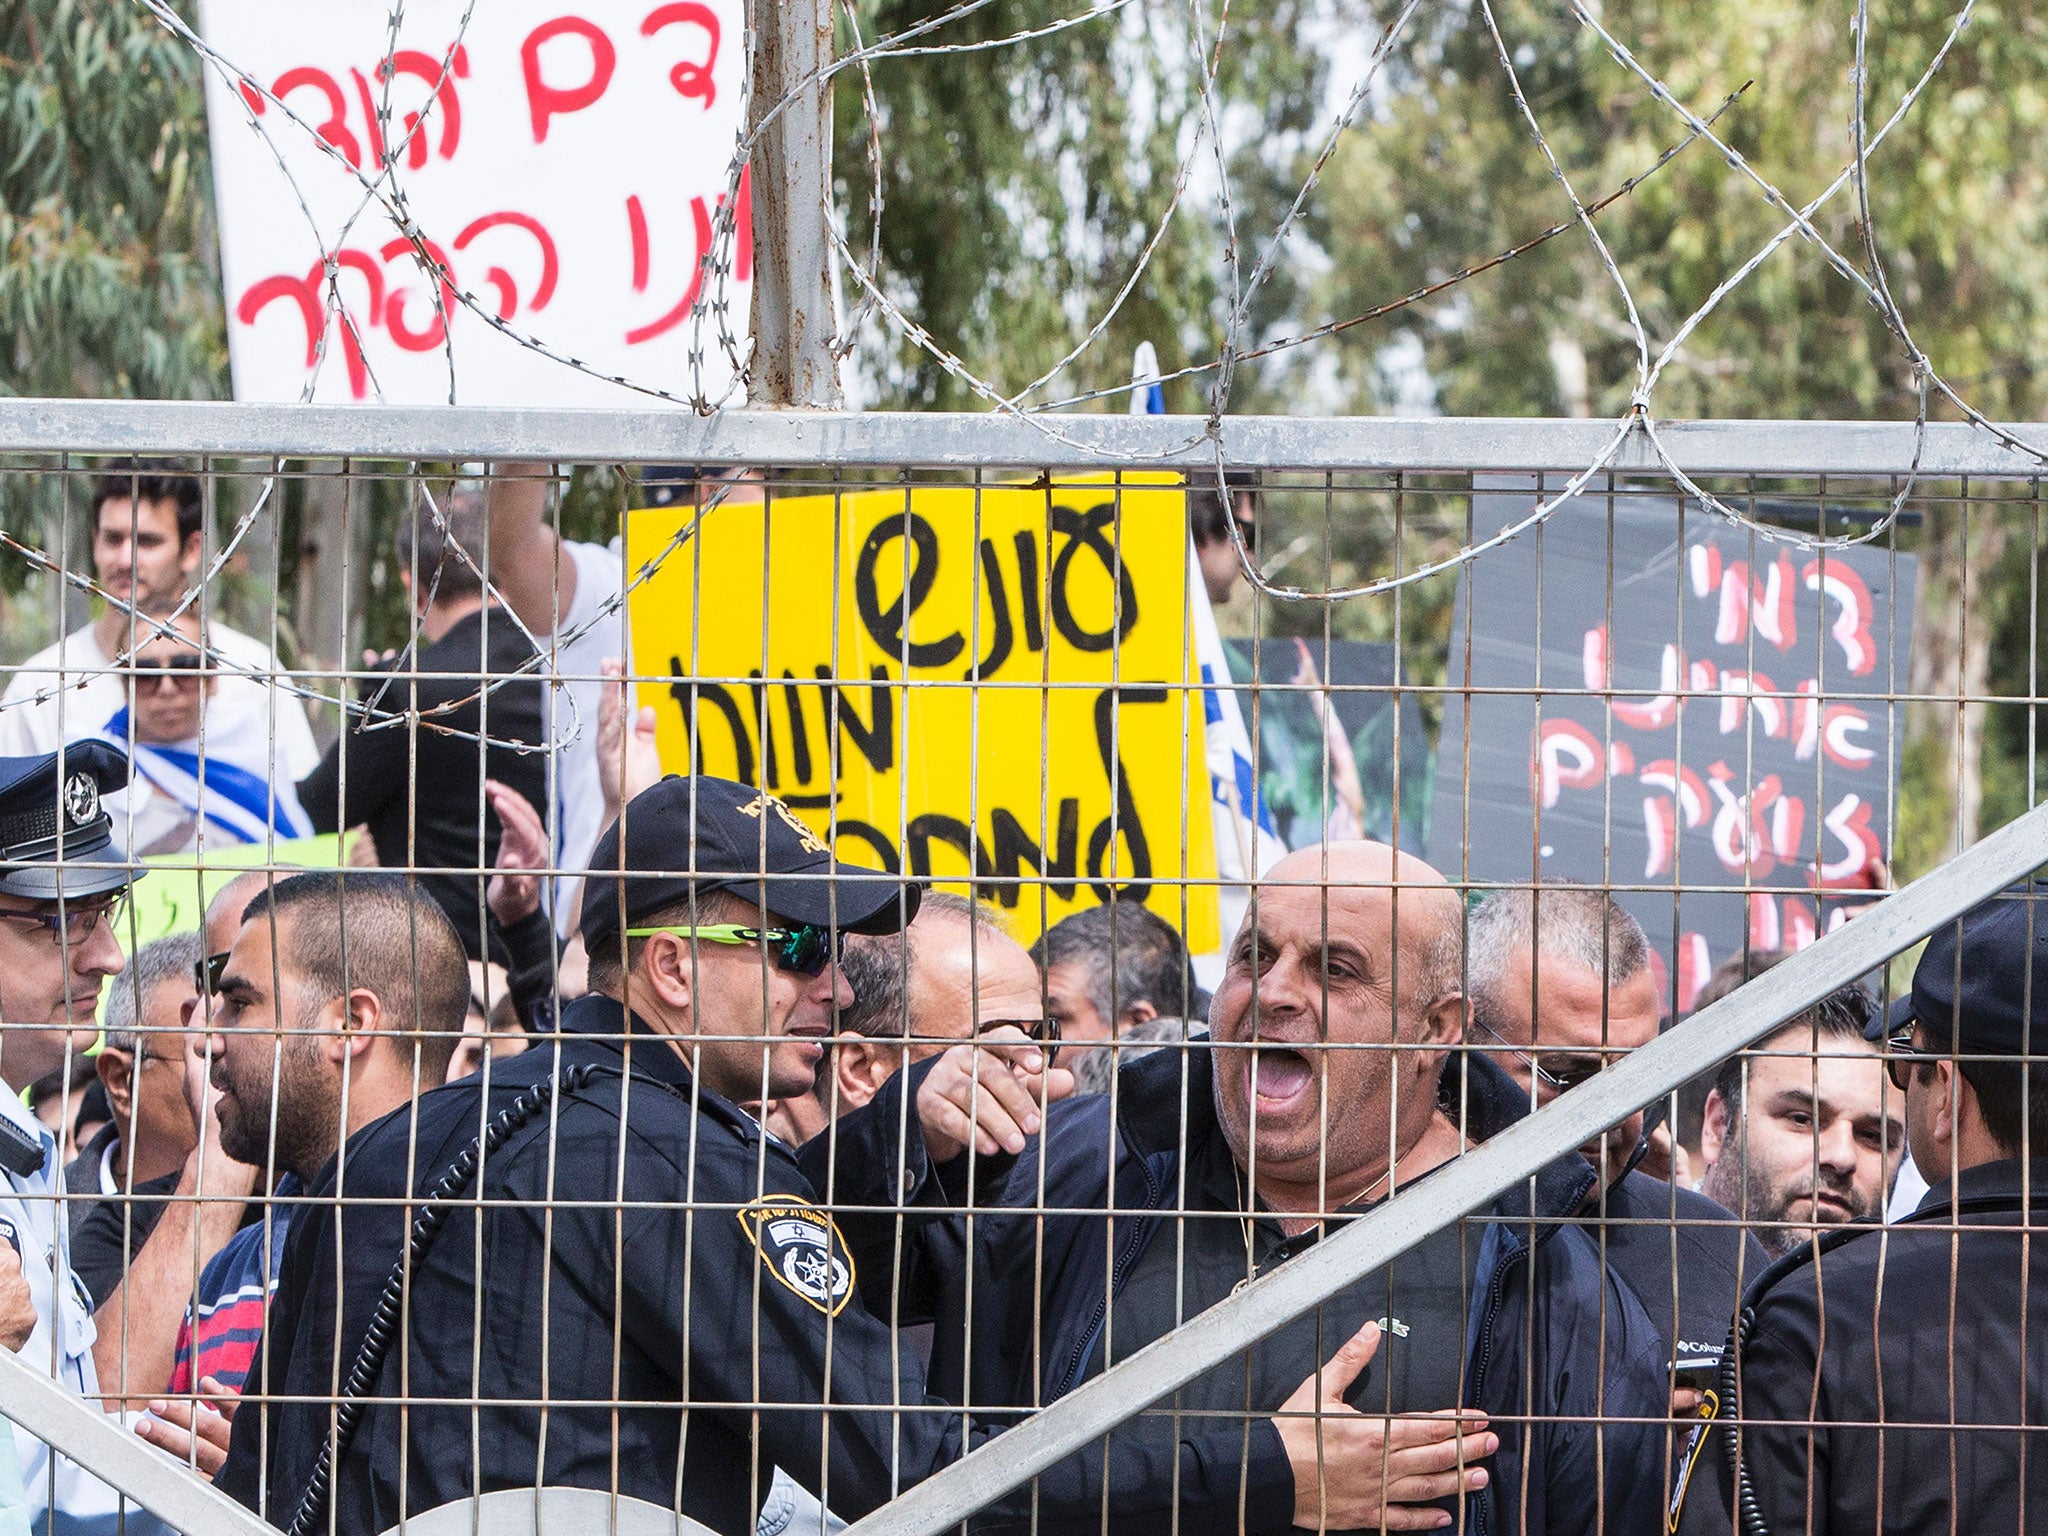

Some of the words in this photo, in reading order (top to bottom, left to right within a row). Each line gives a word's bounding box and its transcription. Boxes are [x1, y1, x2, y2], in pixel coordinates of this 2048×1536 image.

[238, 41, 470, 173] יהודי
[519, 2, 720, 144] דם
[236, 210, 561, 400] הפקר
[855, 502, 1139, 682] עונש
[1689, 540, 1877, 676] דמי
[669, 655, 895, 790] מוות
[1582, 622, 1878, 770] אחינו
[1529, 716, 1882, 899] צועקים
[1688, 1341, 1726, 1354] Colum
